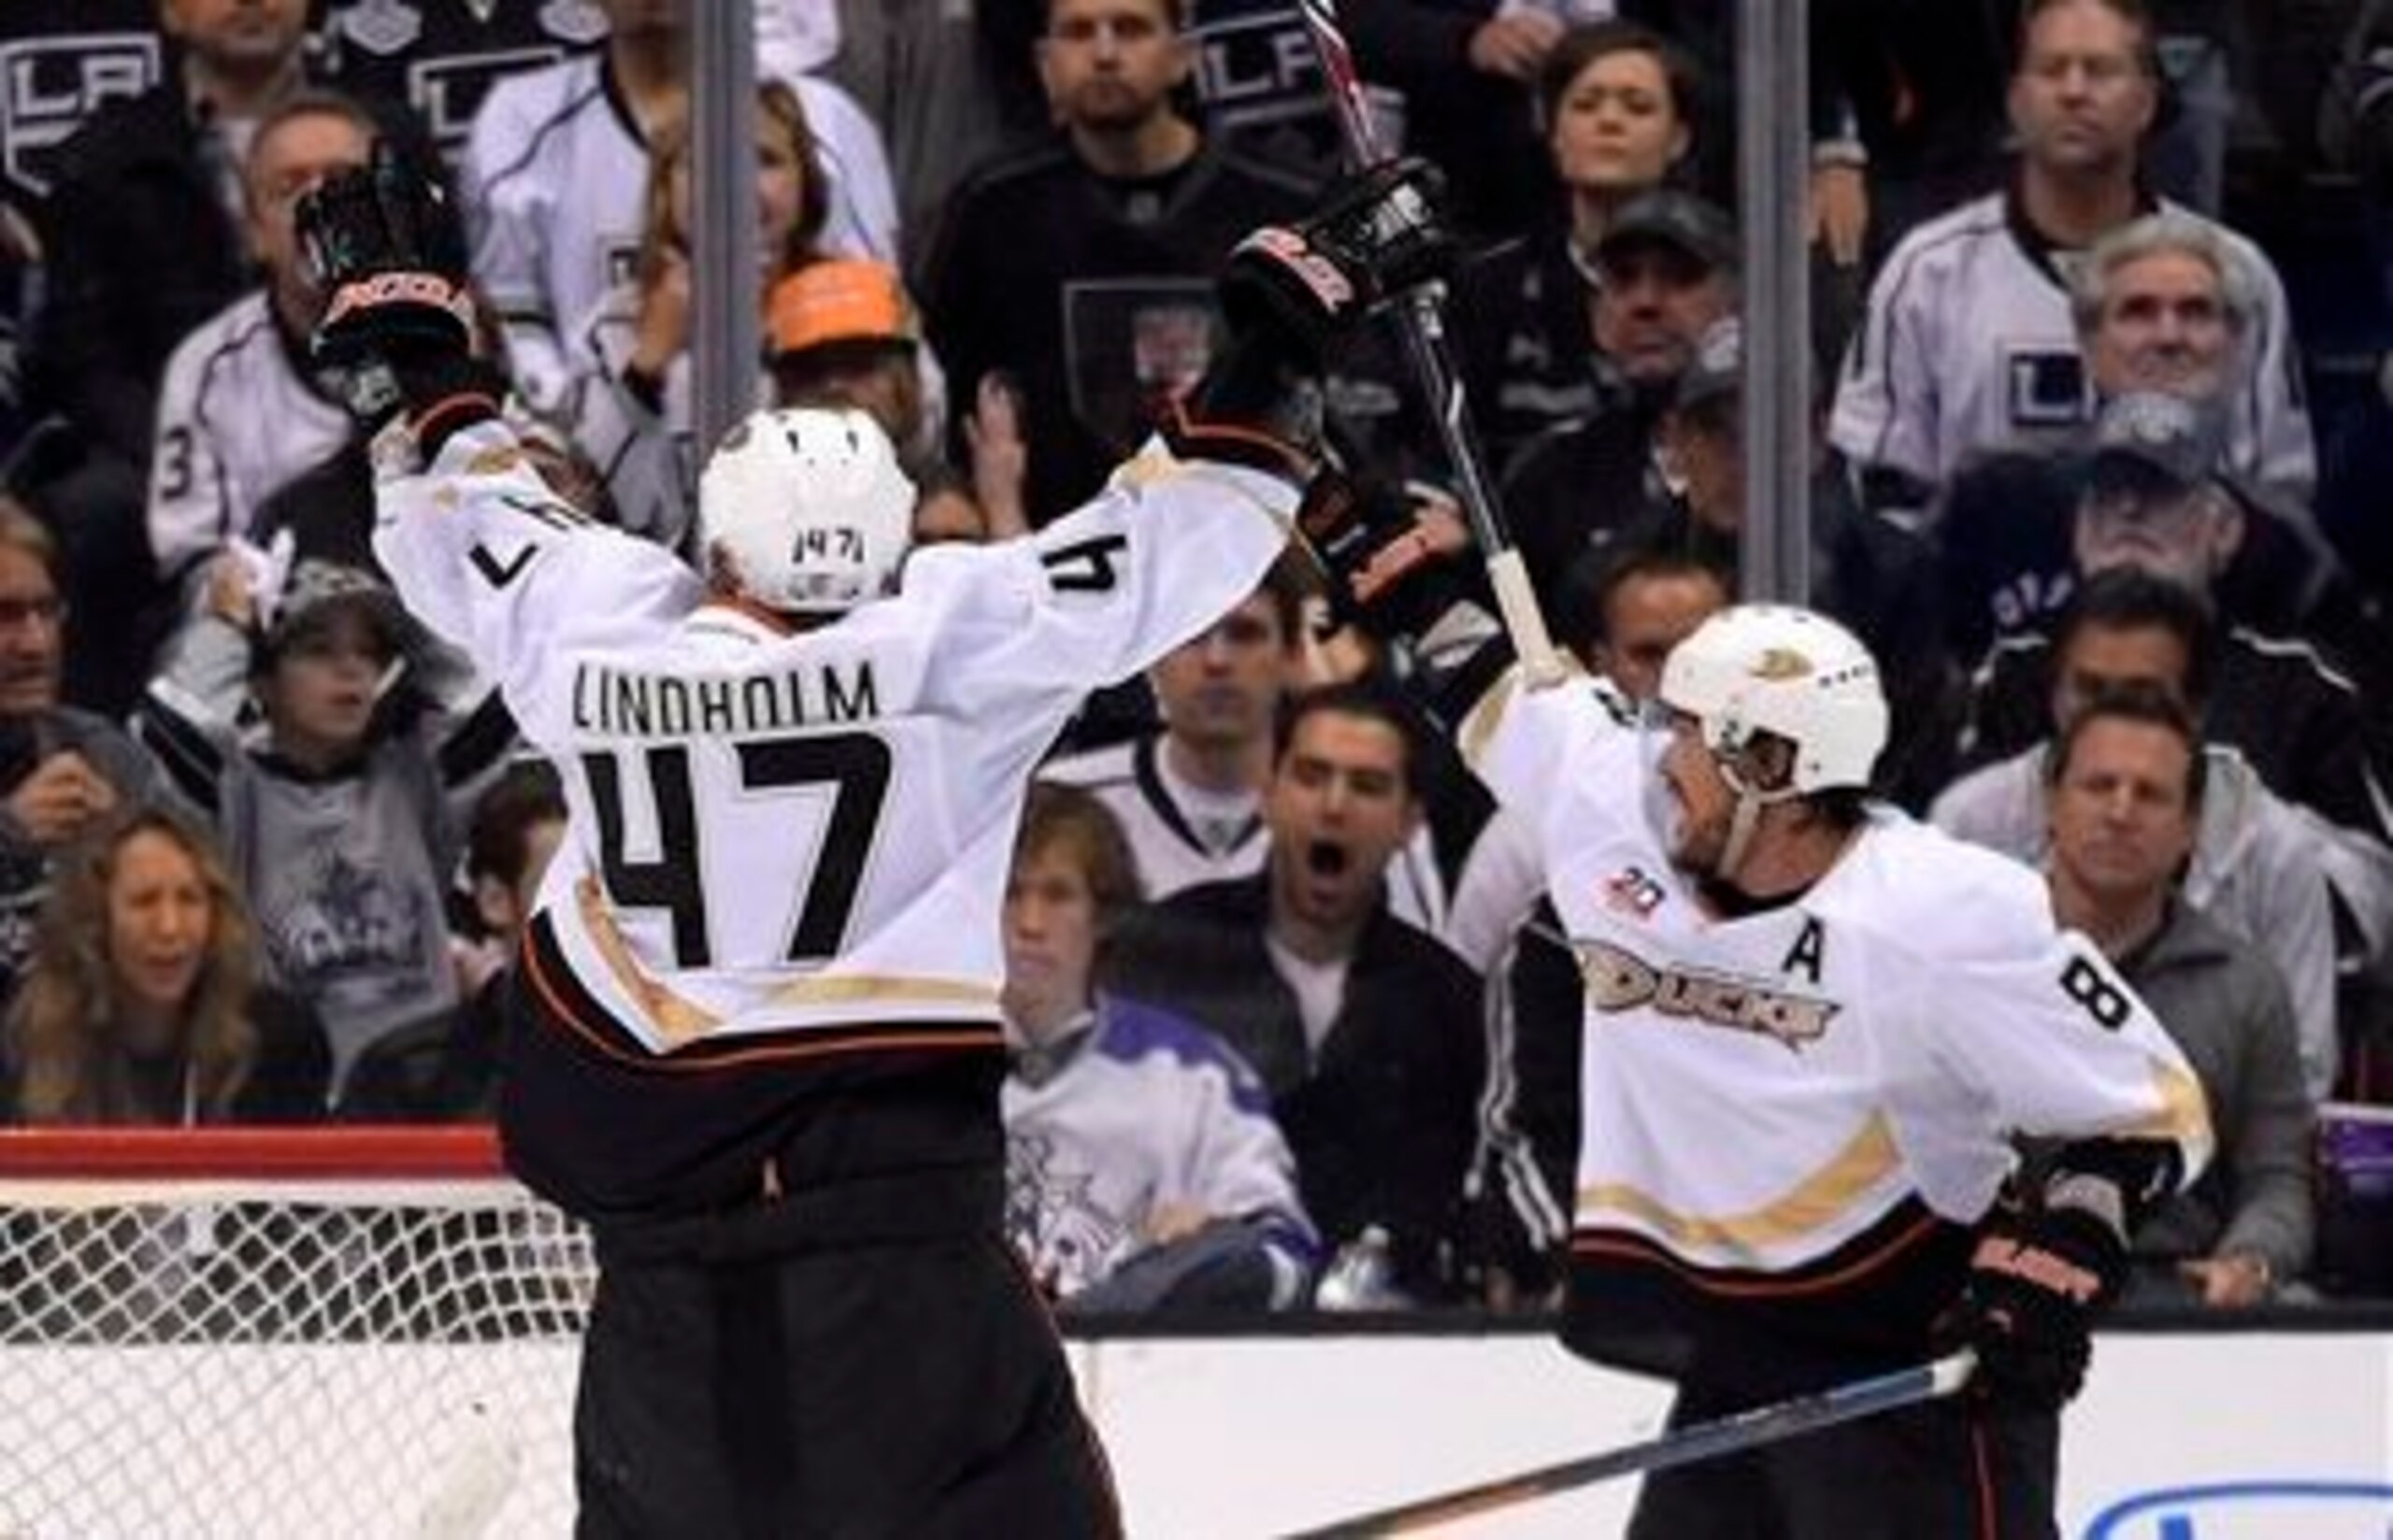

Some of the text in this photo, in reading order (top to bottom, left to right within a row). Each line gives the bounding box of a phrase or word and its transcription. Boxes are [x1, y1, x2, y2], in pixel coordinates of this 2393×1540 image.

[163, 426, 193, 500] 3
[573, 661, 879, 735] LINDHOLM
[579, 731, 894, 968] 47
[1781, 916, 1825, 983] A
[2058, 954, 2133, 1034] 8
